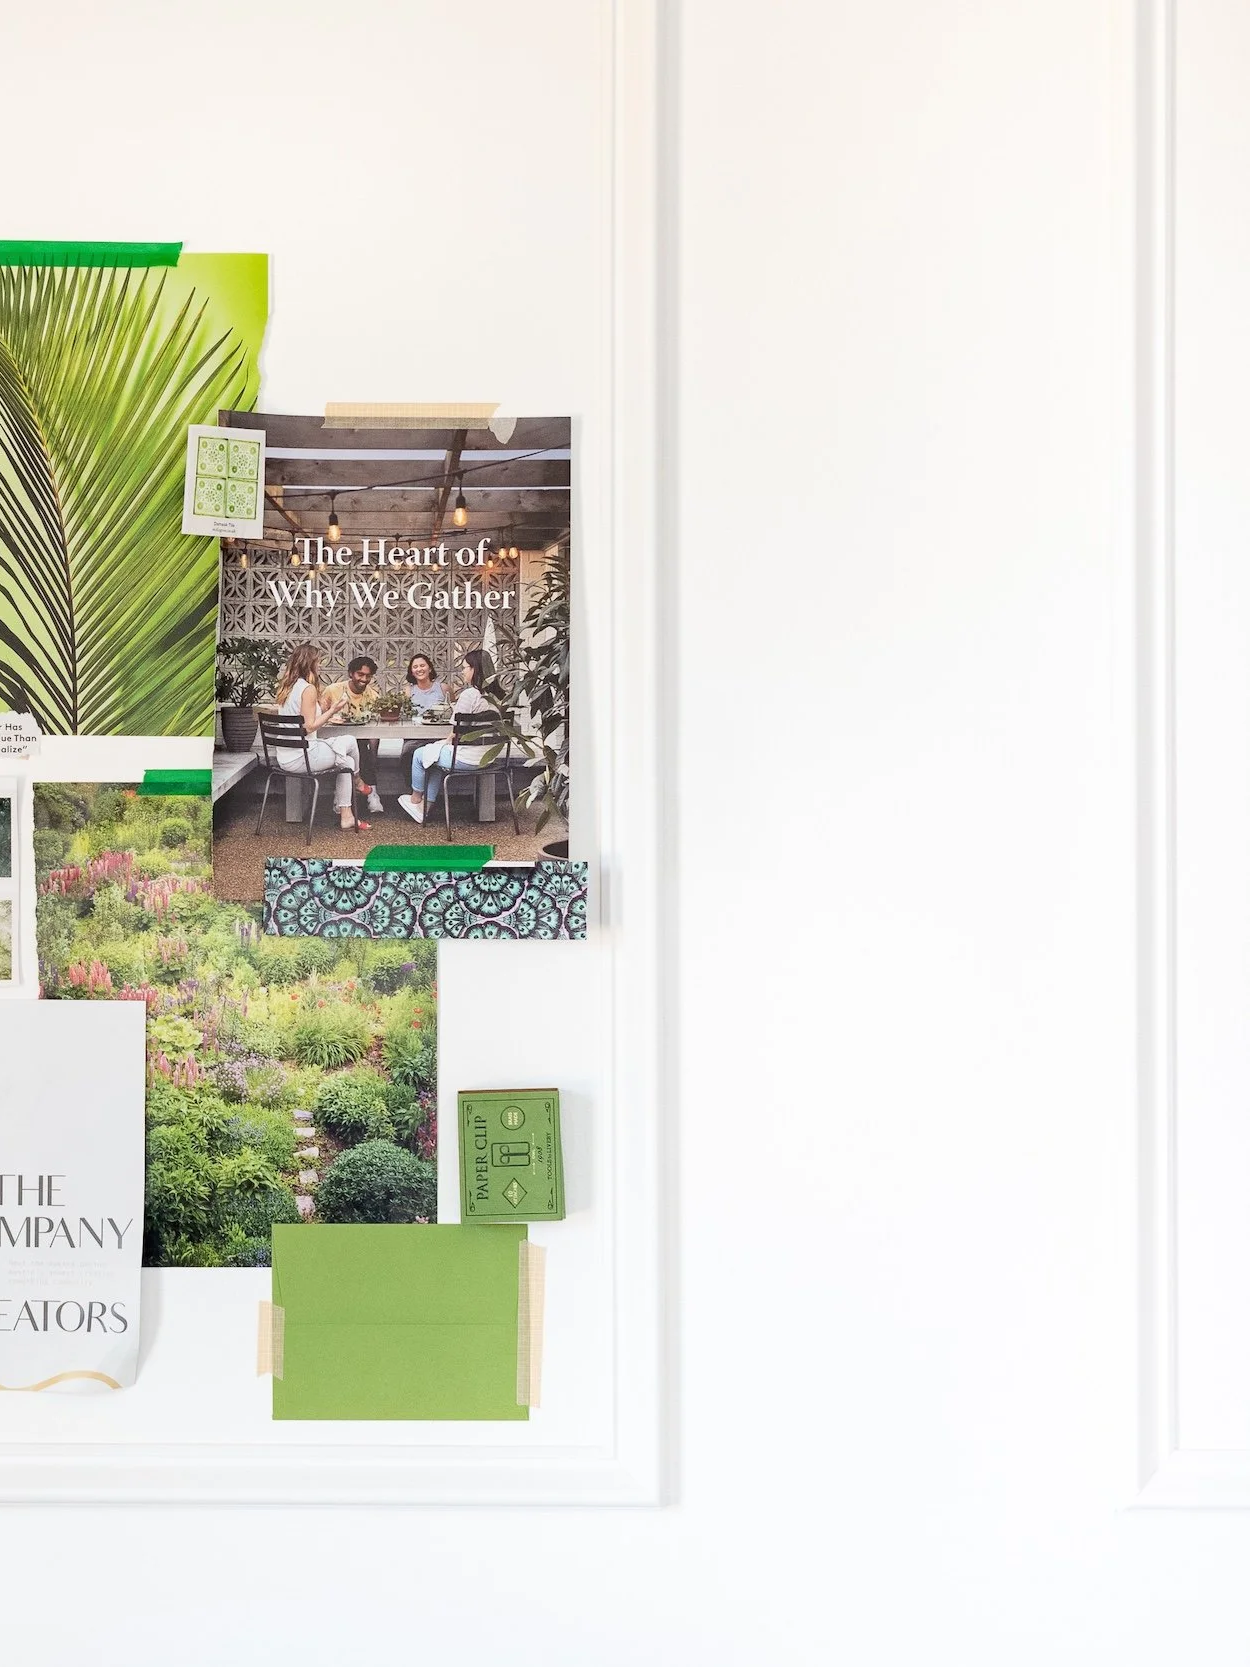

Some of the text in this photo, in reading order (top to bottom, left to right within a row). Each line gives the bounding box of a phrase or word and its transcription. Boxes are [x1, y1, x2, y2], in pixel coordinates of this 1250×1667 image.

[295, 536, 491, 567] The Heart of
[267, 580, 515, 616] Why We Gather
[5, 723, 22, 731] Has
[474, 1115, 489, 1200] PAPER CLIP
